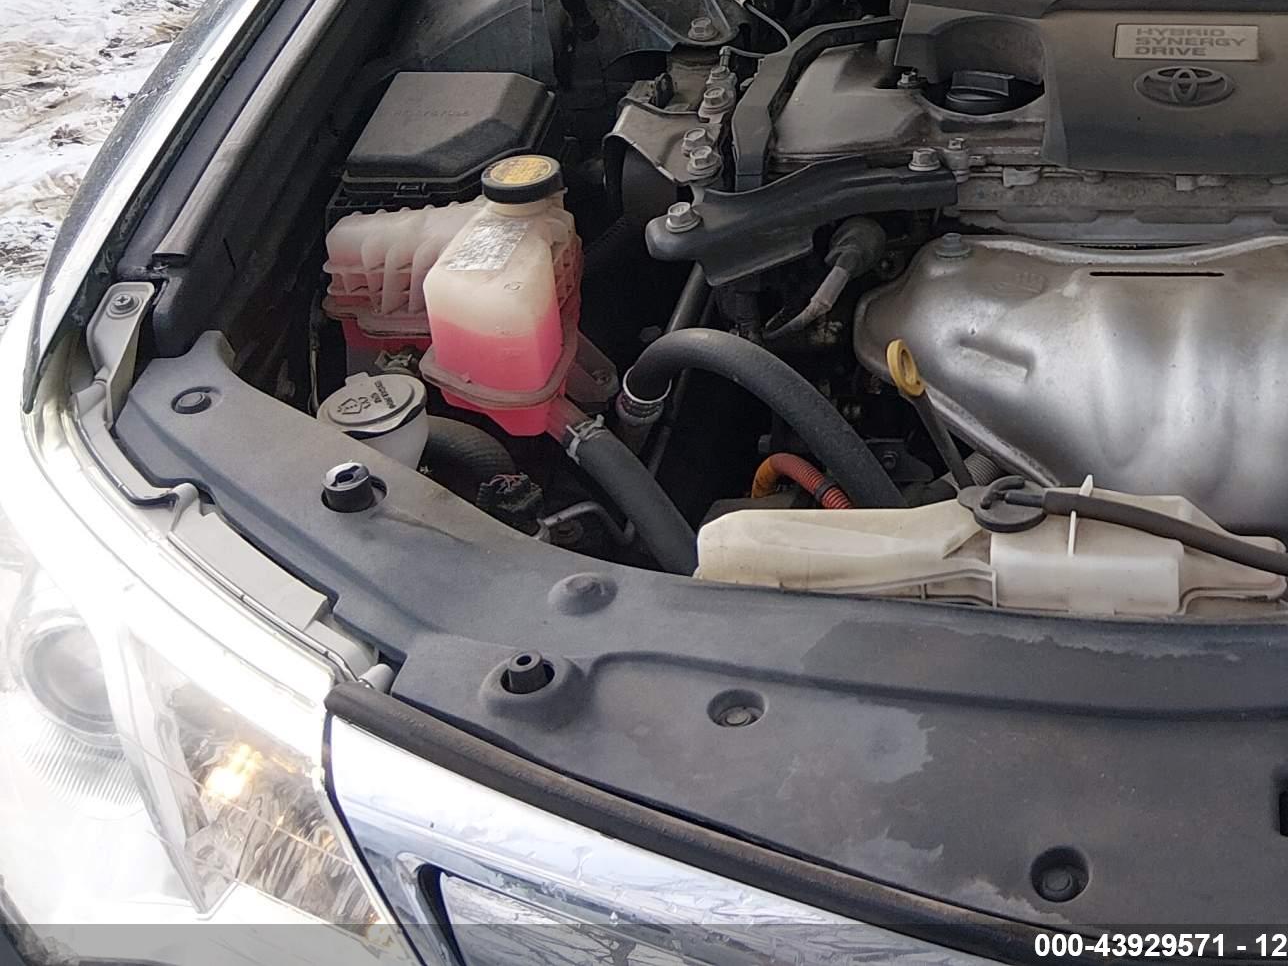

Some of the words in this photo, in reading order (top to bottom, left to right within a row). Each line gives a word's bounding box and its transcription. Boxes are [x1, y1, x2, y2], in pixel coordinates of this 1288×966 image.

[1136, 28, 1225, 37] HYBRID
[1135, 37, 1246, 46] SYNERGY
[1135, 46, 1207, 56] DRIVE
